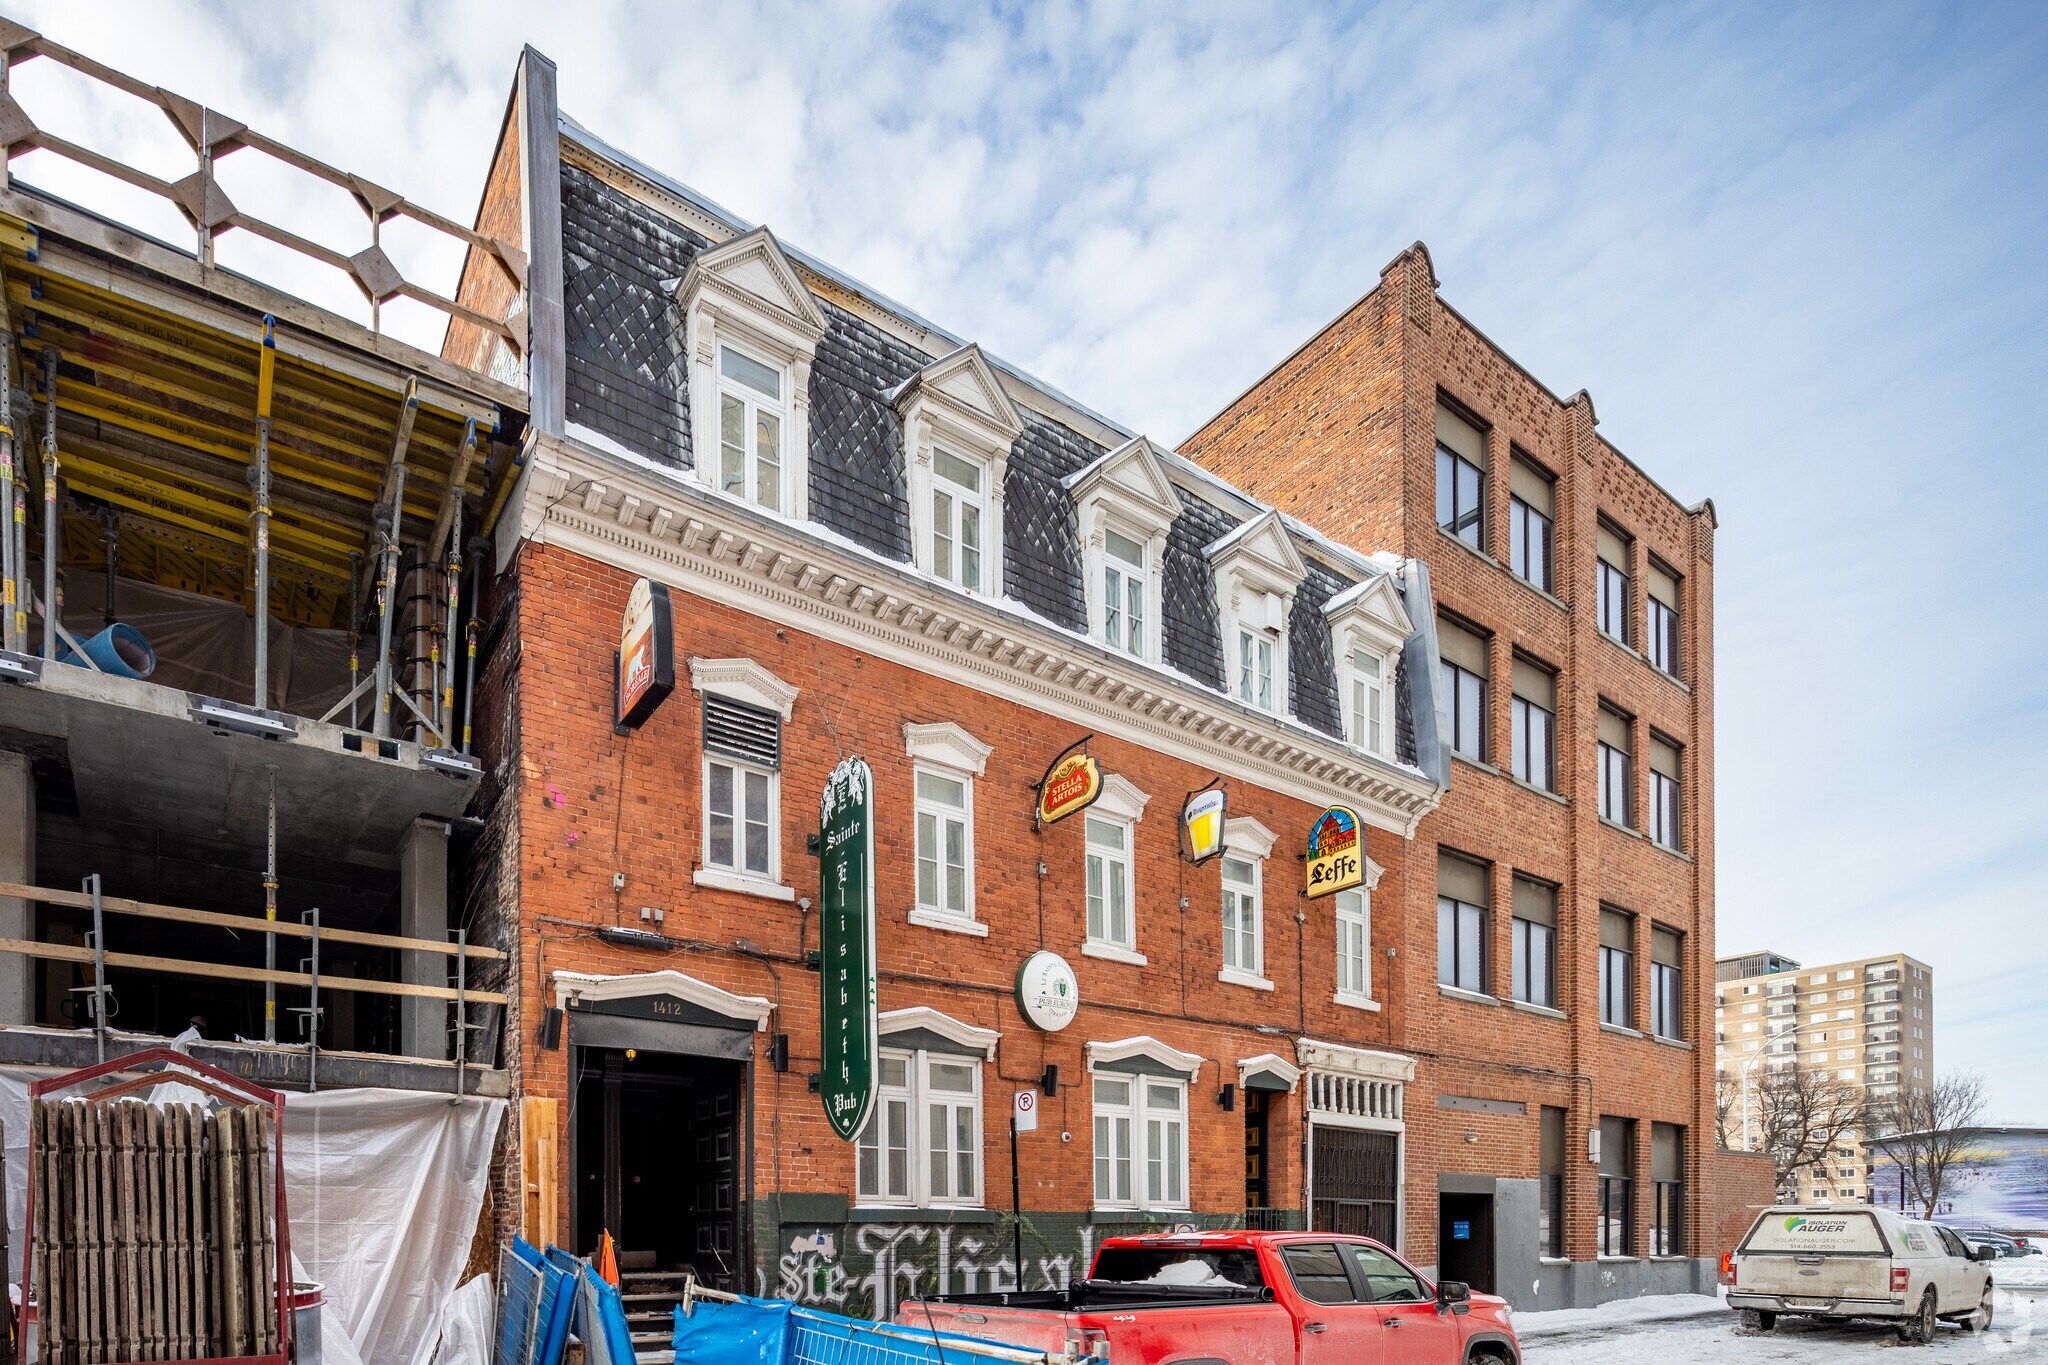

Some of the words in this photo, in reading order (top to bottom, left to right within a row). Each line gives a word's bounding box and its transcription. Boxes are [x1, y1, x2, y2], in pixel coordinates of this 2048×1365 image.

[167, 332, 182, 346] top
[108, 404, 144, 420] doka
[149, 415, 167, 427] H20
[170, 420, 184, 433] top
[174, 479, 200, 496] 2.90m
[115, 487, 146, 503] doka
[151, 497, 167, 510] H20
[170, 503, 184, 515] top
[185, 508, 192, 517] P
[218, 518, 243, 535] 2.90m
[1051, 783, 1083, 806] ARTOIS
[1052, 774, 1082, 796] STELLA
[826, 819, 860, 852] Sainte
[1308, 855, 1357, 887] Leffe
[653, 1001, 681, 1015] 1412
[834, 1092, 857, 1117] Pub
